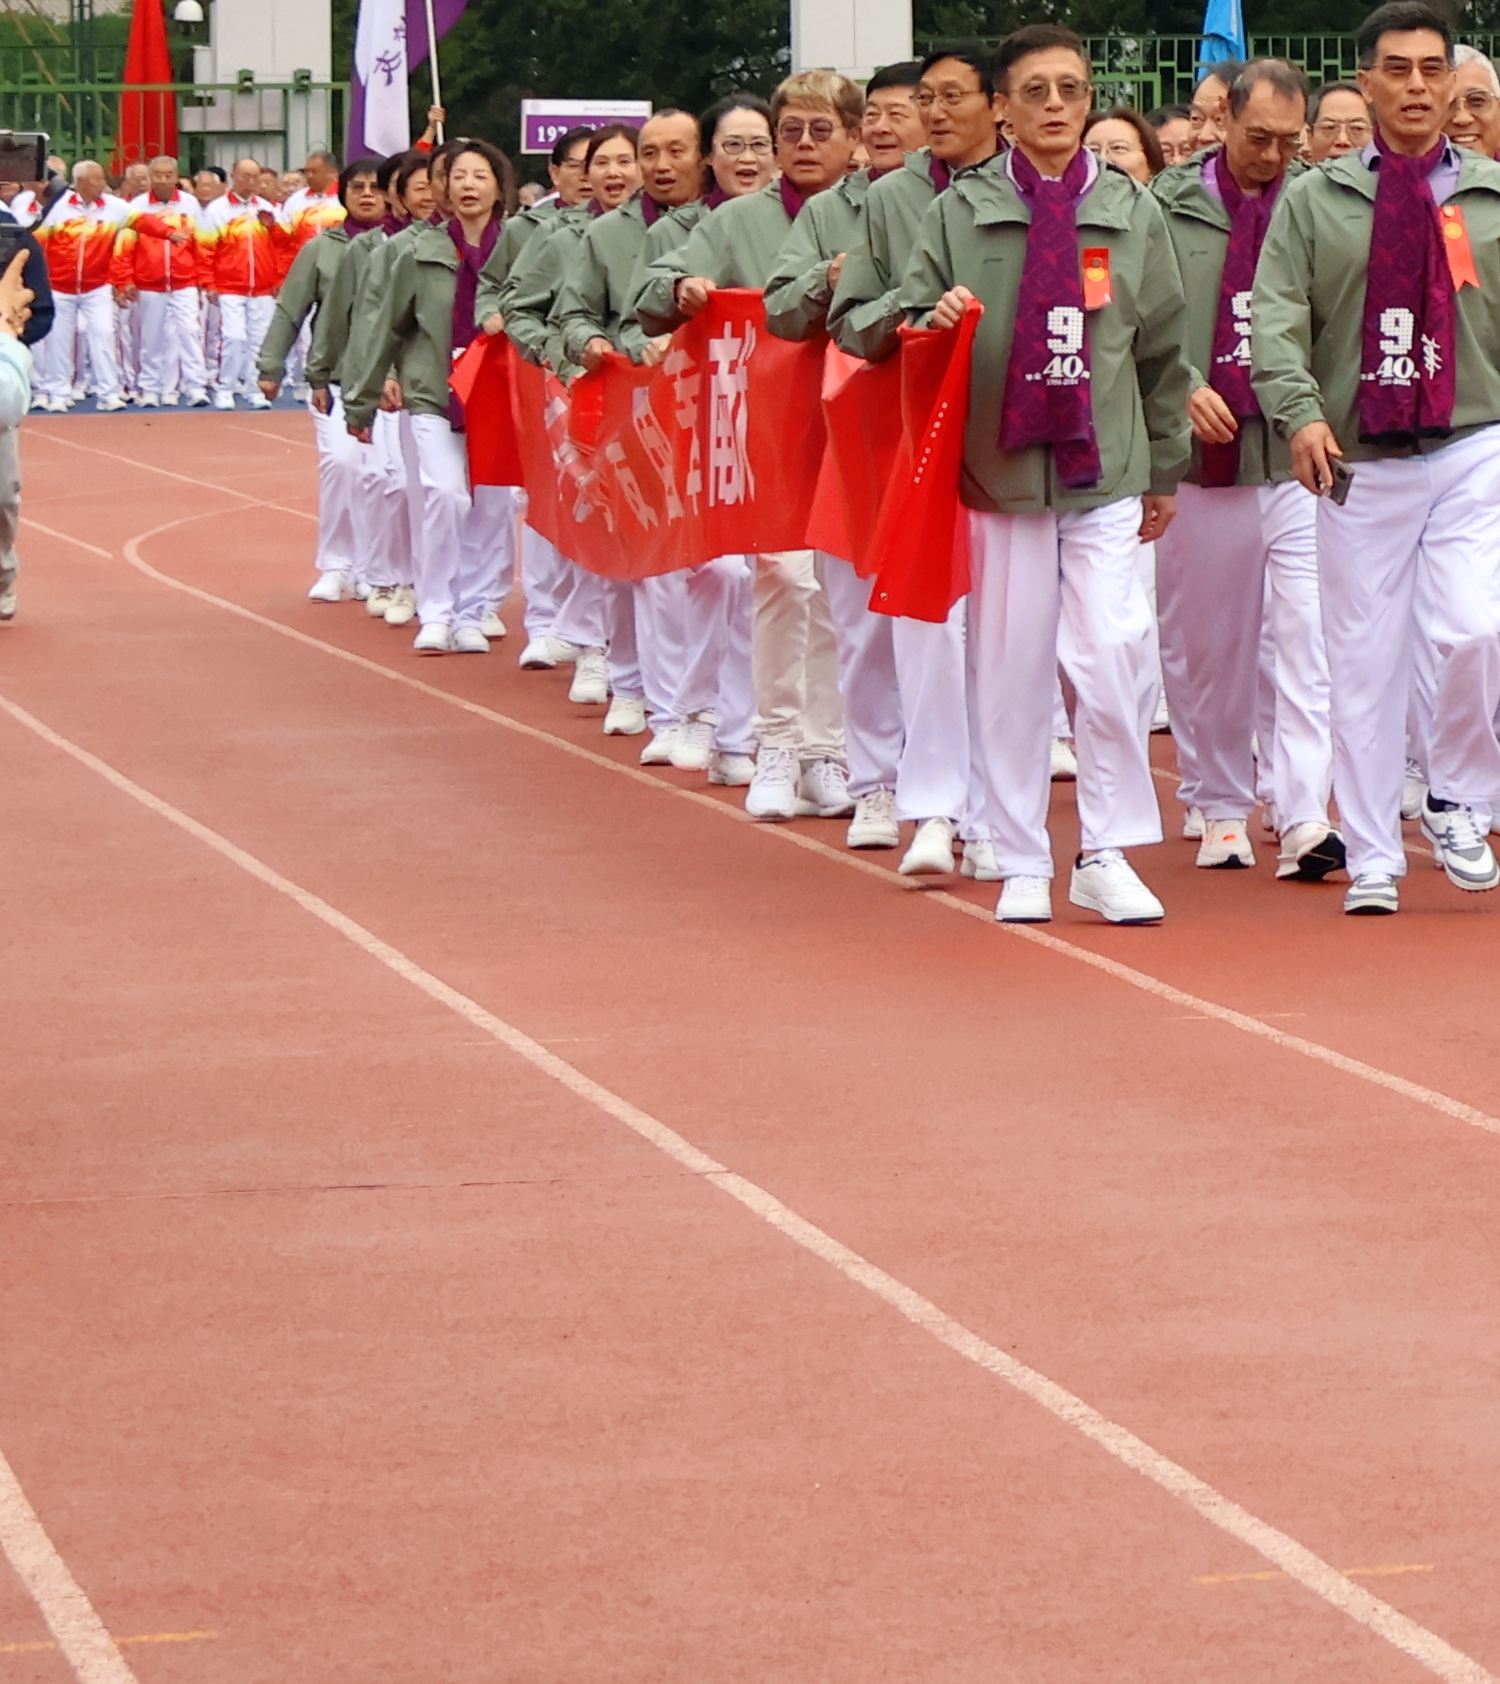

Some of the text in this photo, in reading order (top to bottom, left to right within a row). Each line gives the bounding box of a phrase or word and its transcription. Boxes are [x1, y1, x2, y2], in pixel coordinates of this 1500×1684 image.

[1046, 306, 1085, 354] 9
[1379, 307, 1415, 354] 9
[1042, 355, 1085, 379] 40
[1375, 356, 1416, 379] 40
